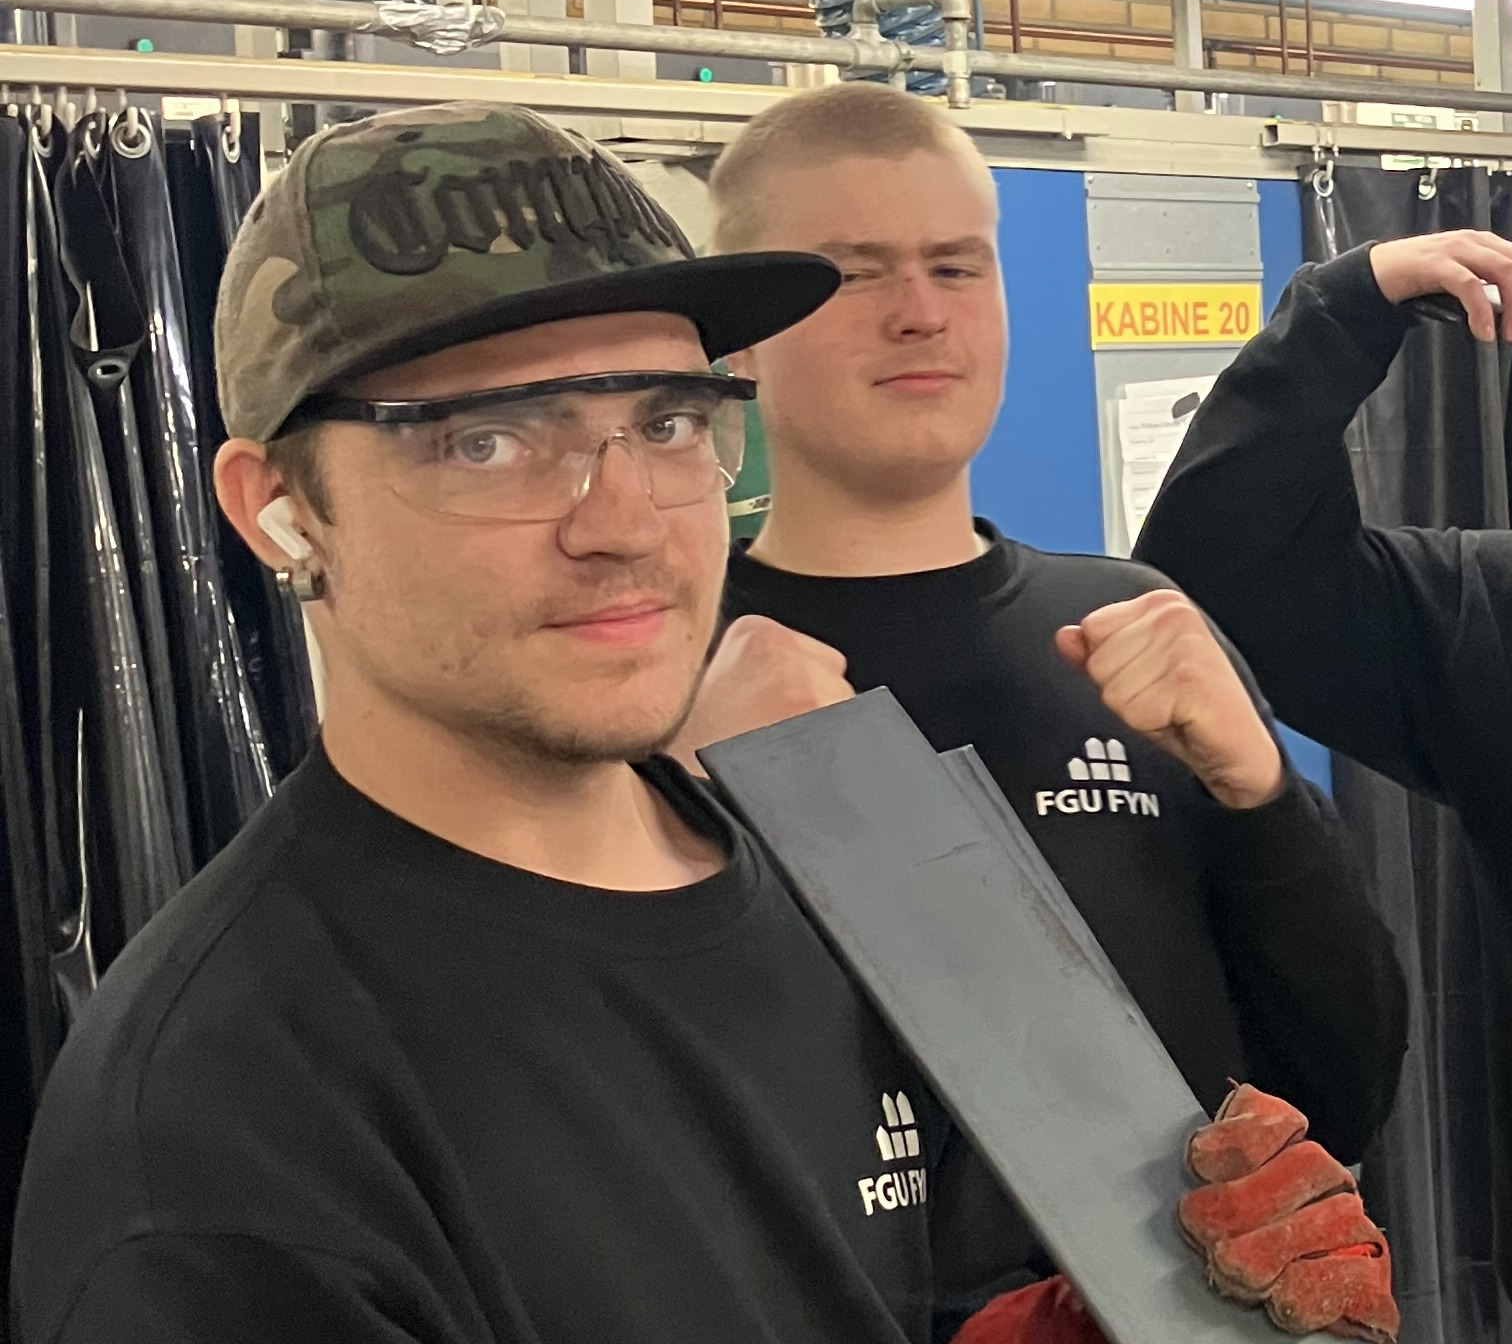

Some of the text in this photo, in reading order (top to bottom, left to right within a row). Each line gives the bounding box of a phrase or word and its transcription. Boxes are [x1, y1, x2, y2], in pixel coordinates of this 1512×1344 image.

[1096, 301, 1250, 337] KABINE 20
[1036, 789, 1160, 817] FGU FYN
[857, 1170, 910, 1216] FGU
